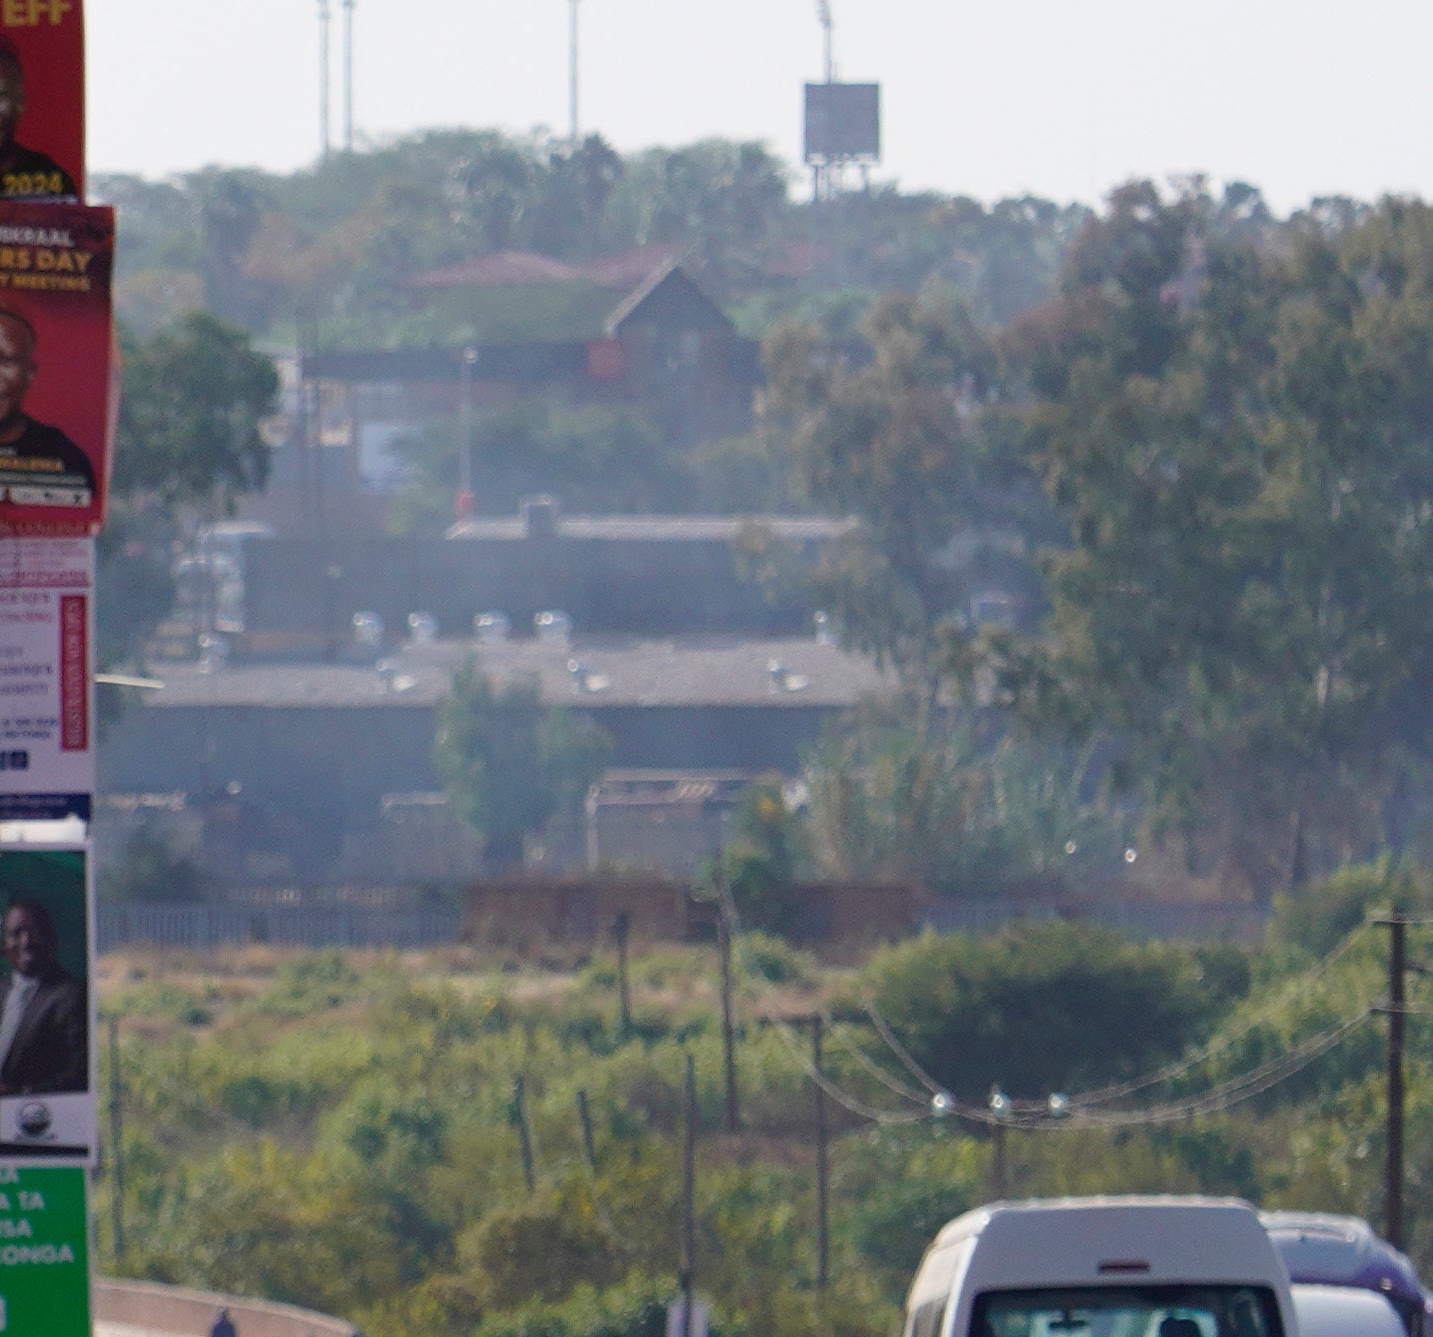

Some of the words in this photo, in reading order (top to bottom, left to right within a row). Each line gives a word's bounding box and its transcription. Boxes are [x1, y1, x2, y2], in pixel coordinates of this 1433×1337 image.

[1, 0, 73, 27] EFF
[3, 171, 64, 195] 2024
[36, 249, 93, 273] DAY
[18, 1190, 45, 1211] TA
